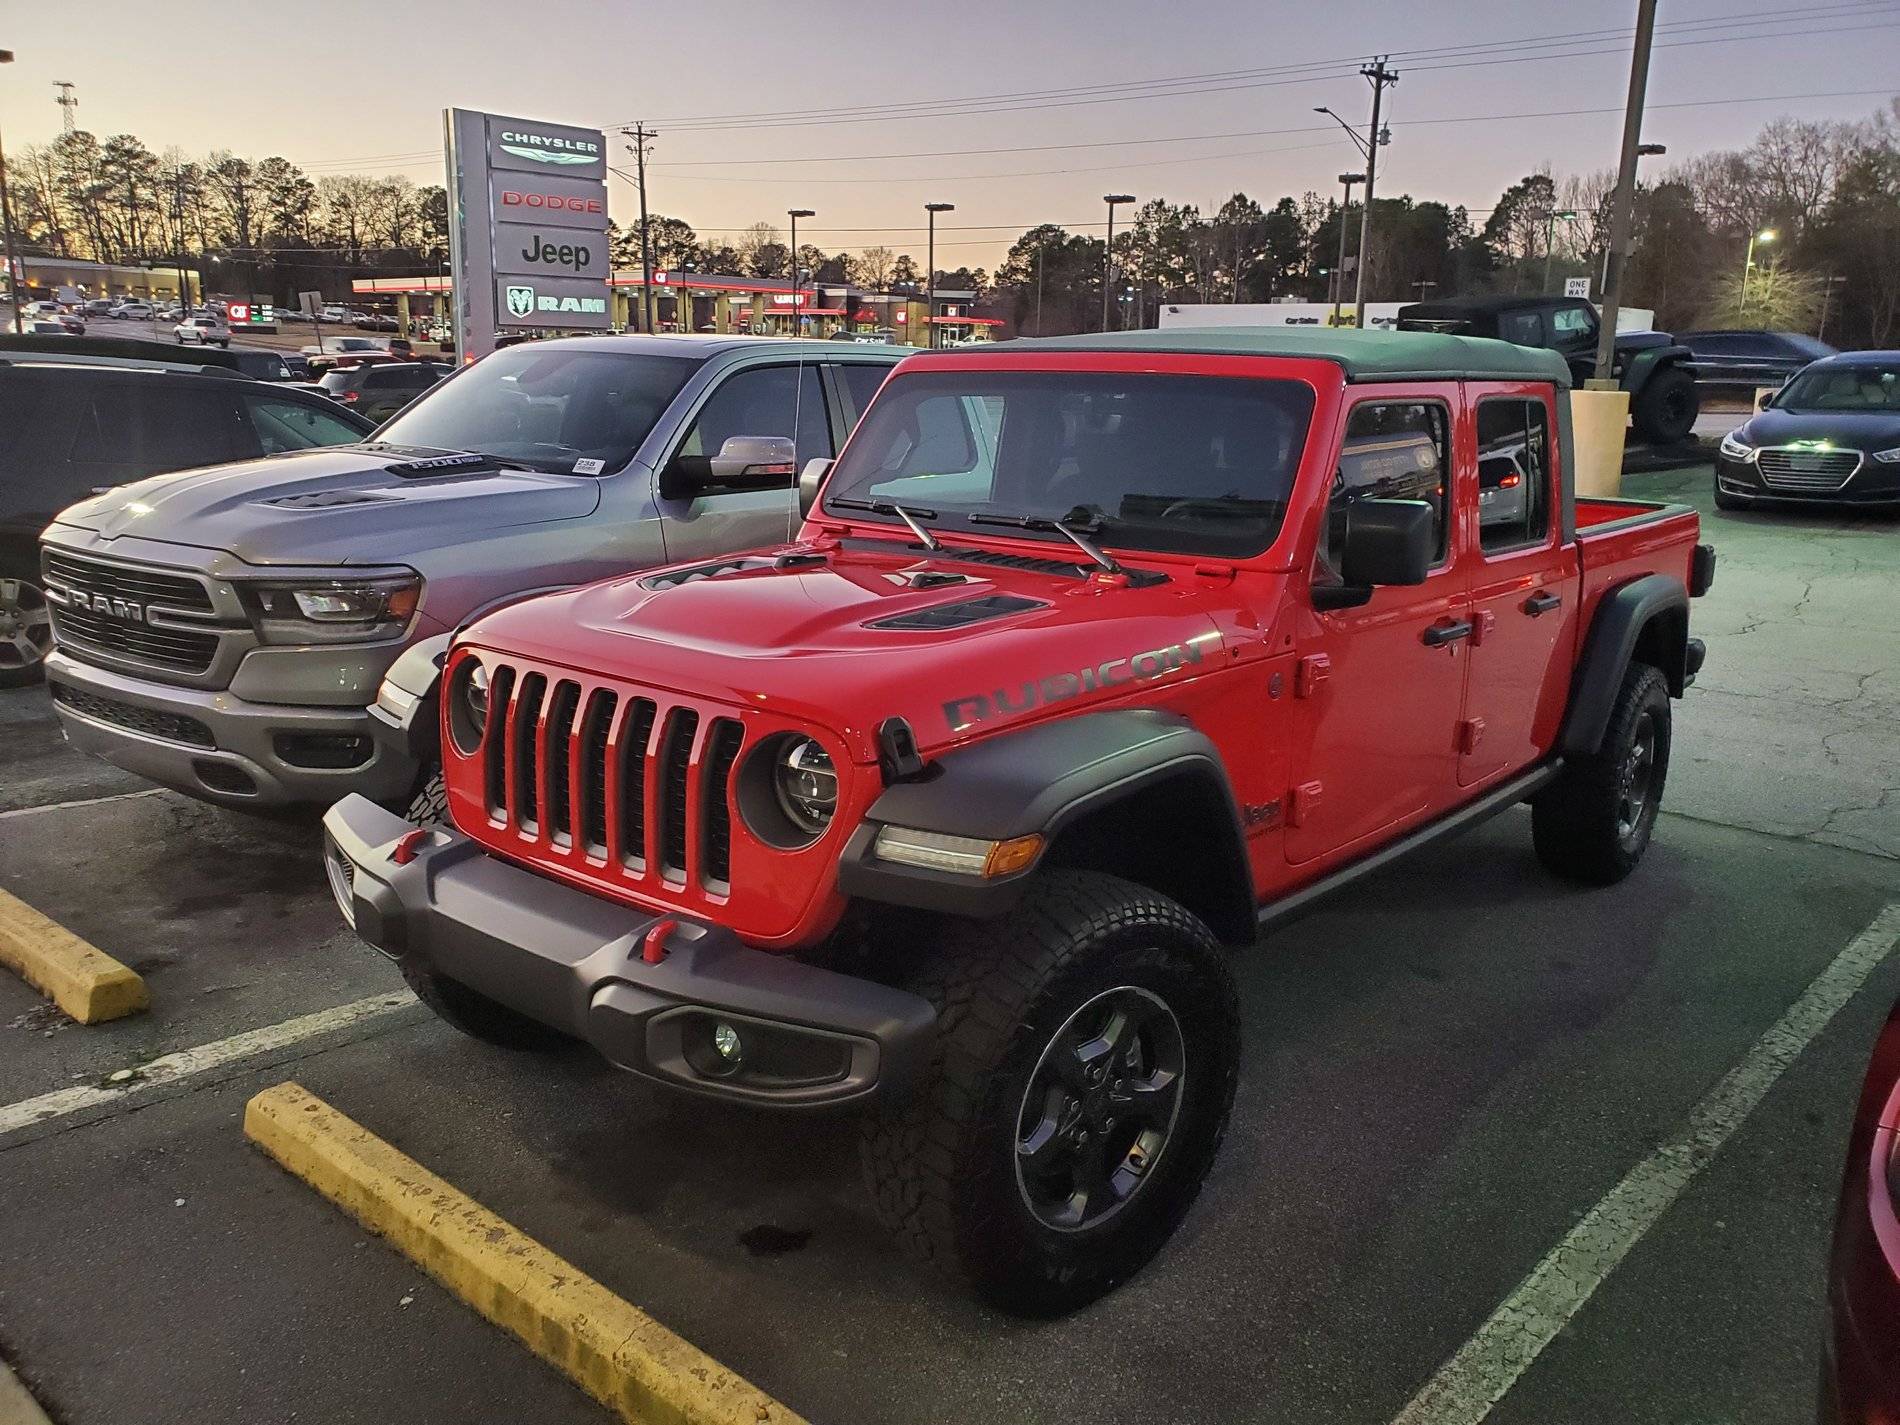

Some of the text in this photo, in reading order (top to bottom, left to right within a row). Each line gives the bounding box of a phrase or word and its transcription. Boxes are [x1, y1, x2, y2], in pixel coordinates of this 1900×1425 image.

[501, 131, 598, 152] CHRYSLER
[503, 191, 602, 214] DODGE
[522, 235, 591, 271] Jeep
[1569, 280, 1586, 288] ONE
[537, 296, 606, 313] RAM
[408, 457, 463, 470] 1500
[67, 588, 142, 621] RAM
[942, 639, 1204, 732] RUBICON
